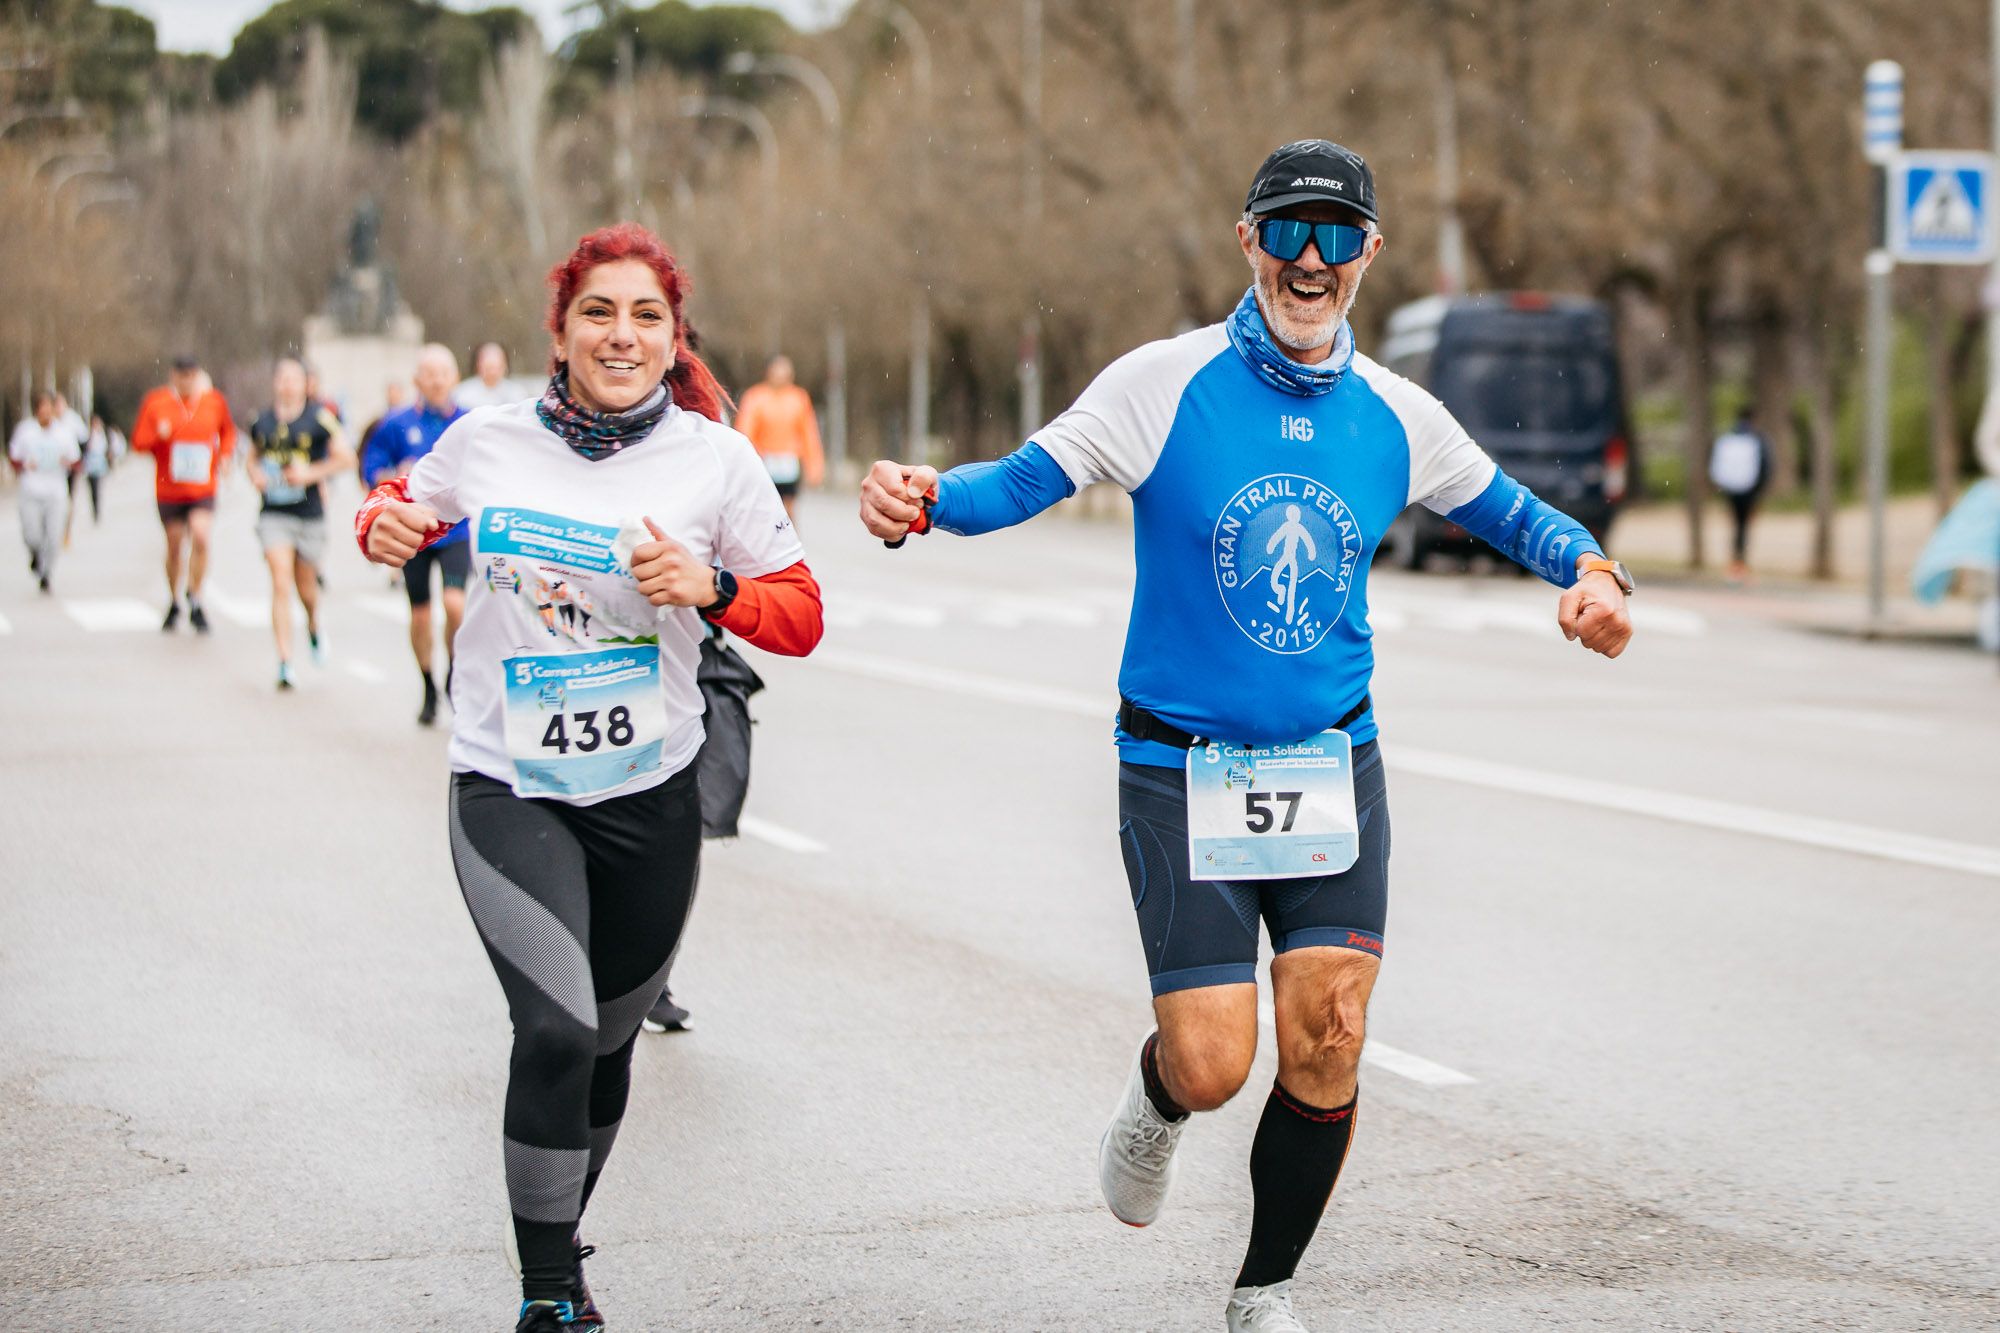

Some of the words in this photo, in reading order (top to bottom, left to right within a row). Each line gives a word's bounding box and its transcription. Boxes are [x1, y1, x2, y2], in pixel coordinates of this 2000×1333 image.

[1304, 177, 1344, 191] TERREX
[1235, 479, 1297, 515] TRAIL
[509, 516, 564, 536] Carrera
[566, 527, 614, 546] Solidar
[1303, 483, 1357, 593] PEÑALARA
[1219, 514, 1242, 588] GRAN
[1258, 622, 1315, 648] 2015
[534, 666, 582, 678] Carrera
[583, 657, 636, 675] Solidaria
[541, 705, 635, 755] 438
[1224, 746, 1270, 758] Carrera
[1273, 744, 1324, 756] Solidaria
[1245, 792, 1303, 834] 57
[1312, 853, 1328, 862] CSL
